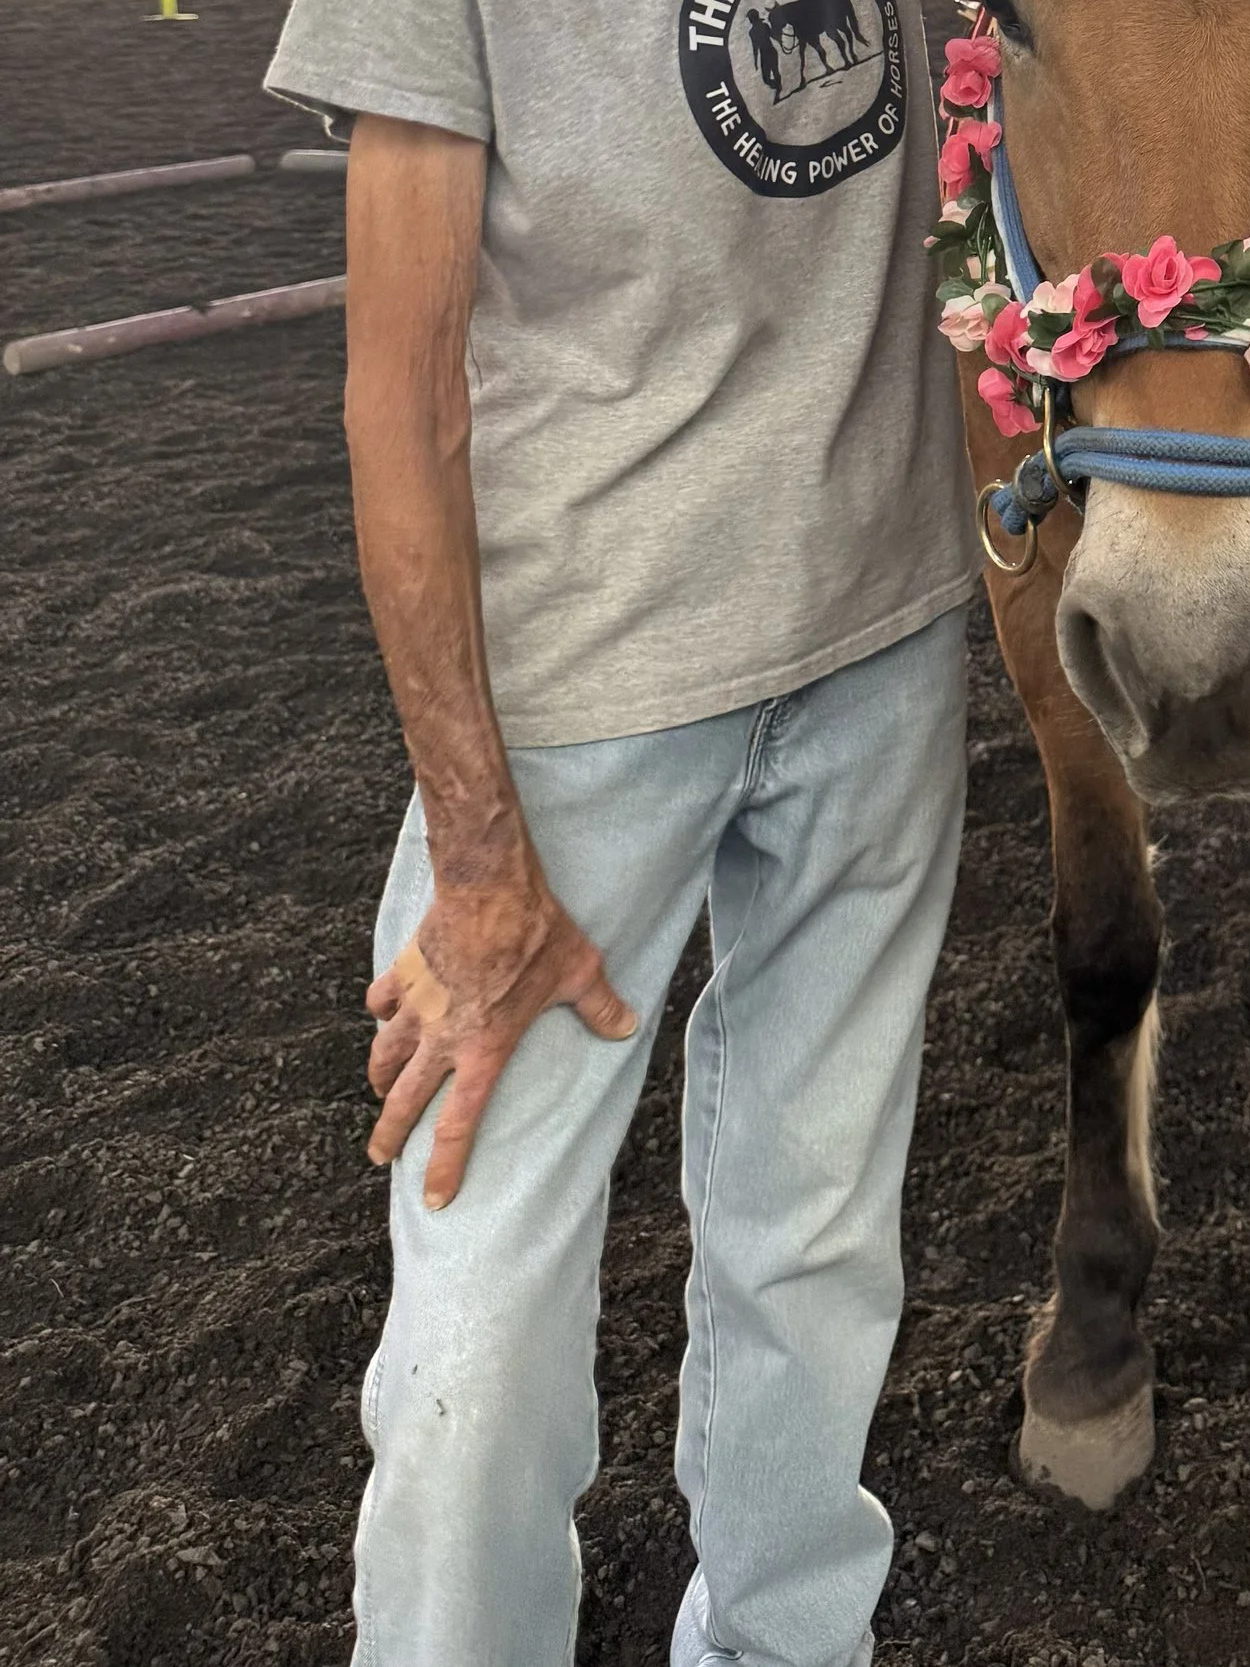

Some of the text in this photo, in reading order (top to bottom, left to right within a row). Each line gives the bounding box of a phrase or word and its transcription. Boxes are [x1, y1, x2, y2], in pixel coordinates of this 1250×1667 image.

[884, 0, 903, 99] HORSES
[705, 80, 742, 137] THE
[878, 102, 900, 135] OF
[808, 132, 880, 184] POWER
